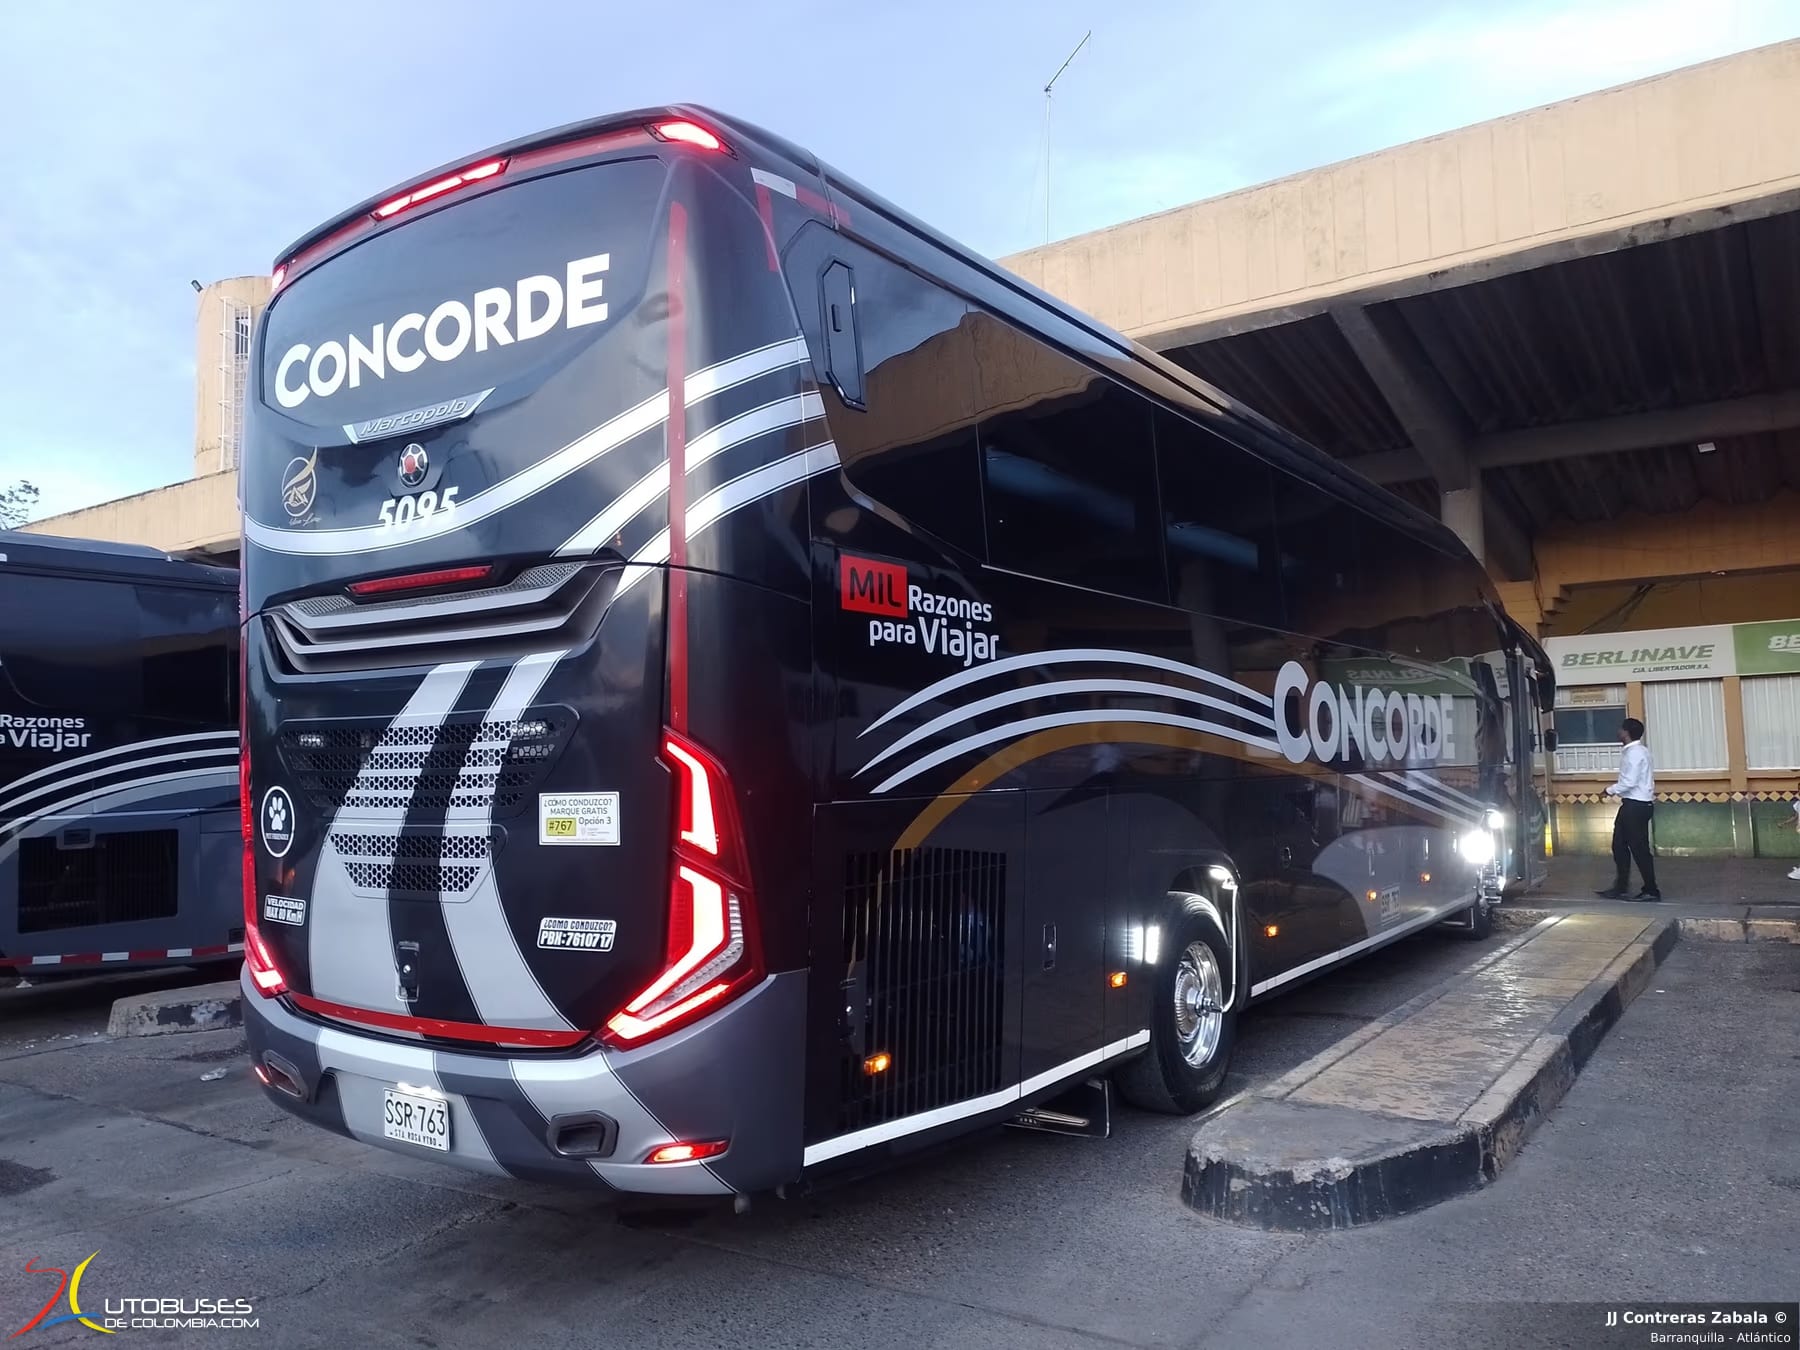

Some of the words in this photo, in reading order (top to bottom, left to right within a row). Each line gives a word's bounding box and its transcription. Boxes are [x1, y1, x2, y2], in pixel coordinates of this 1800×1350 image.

[275, 253, 610, 408] CONCORDE
[360, 399, 467, 436] Marcopolo
[376, 486, 459, 533] 5095
[849, 566, 902, 608] MIL
[908, 584, 993, 622] Razones
[869, 620, 916, 647] para
[918, 616, 1000, 667] Viajar
[1561, 644, 1715, 667] BERLINAVE
[0, 714, 85, 728] Razones
[1274, 660, 1456, 764] CONCORDE
[8, 728, 92, 752] Viajar
[550, 807, 580, 816] MARQUE
[581, 807, 608, 815] GRATIS
[568, 798, 612, 807] CONDUZCO?
[548, 820, 573, 831] #767
[578, 816, 604, 826] Opción
[606, 817, 612, 825] 3
[267, 898, 303, 910] VELOCIDAD
[569, 920, 613, 931] CONDUZCO?
